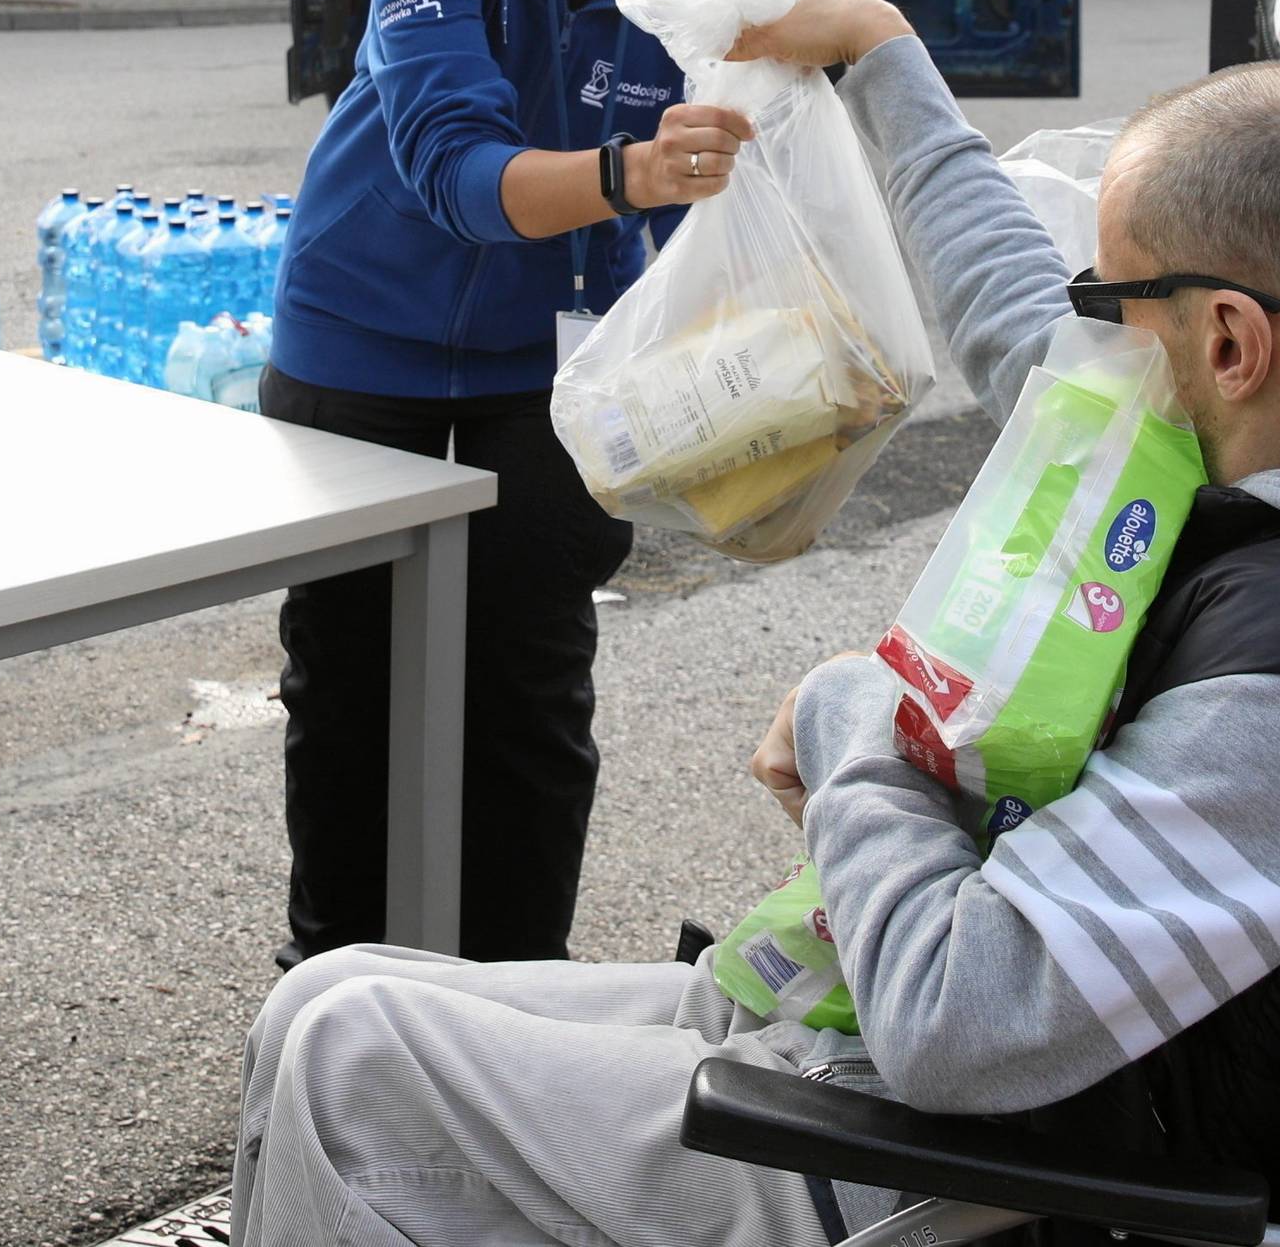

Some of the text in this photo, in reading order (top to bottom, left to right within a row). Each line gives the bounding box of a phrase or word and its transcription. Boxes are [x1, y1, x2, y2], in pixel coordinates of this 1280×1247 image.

[716, 358, 741, 401] OWSIANE
[1108, 503, 1149, 565] alouette
[963, 589, 994, 628] 200
[1087, 586, 1120, 613] 3
